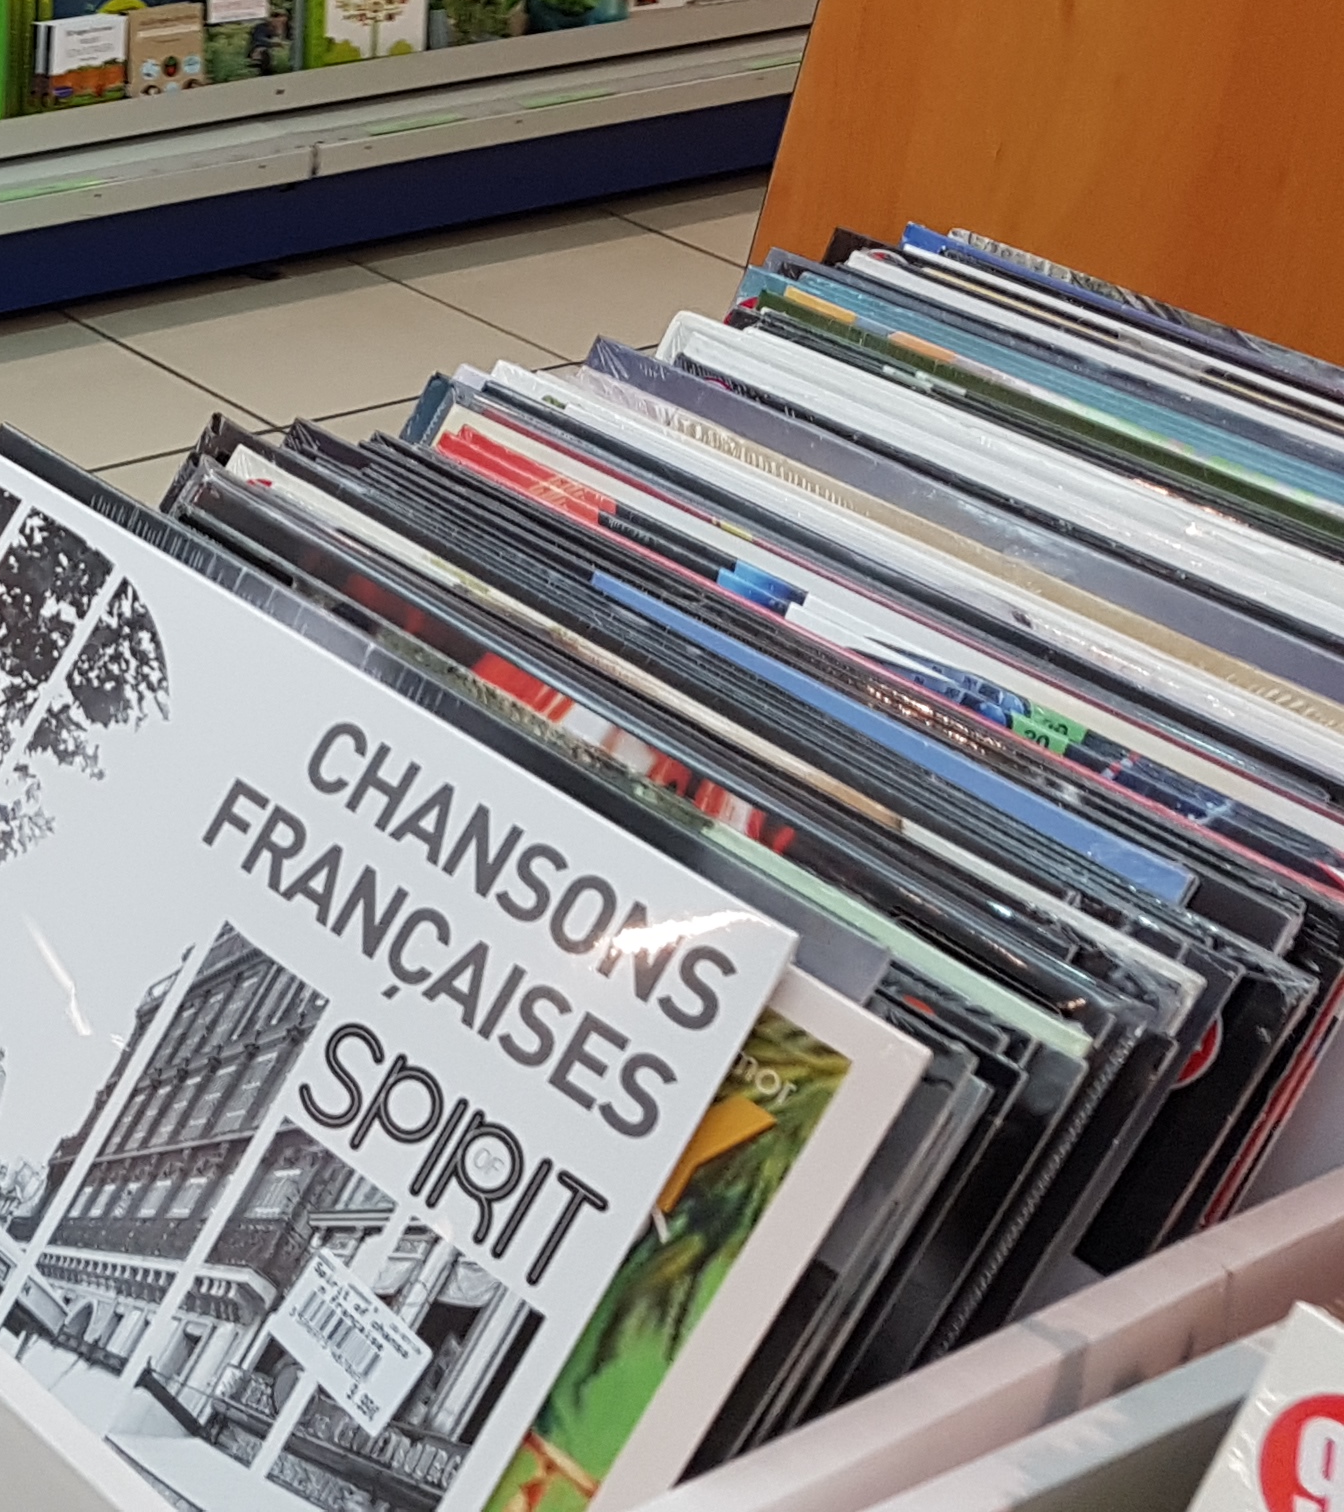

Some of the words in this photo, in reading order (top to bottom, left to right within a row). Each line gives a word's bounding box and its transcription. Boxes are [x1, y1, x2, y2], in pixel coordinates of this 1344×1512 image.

[201, 777, 679, 1139] FRANÇAISES
[306, 721, 739, 1032] CHANSONS
[297, 1021, 611, 1288] SPIRIT
[471, 1145, 505, 1180] OF
